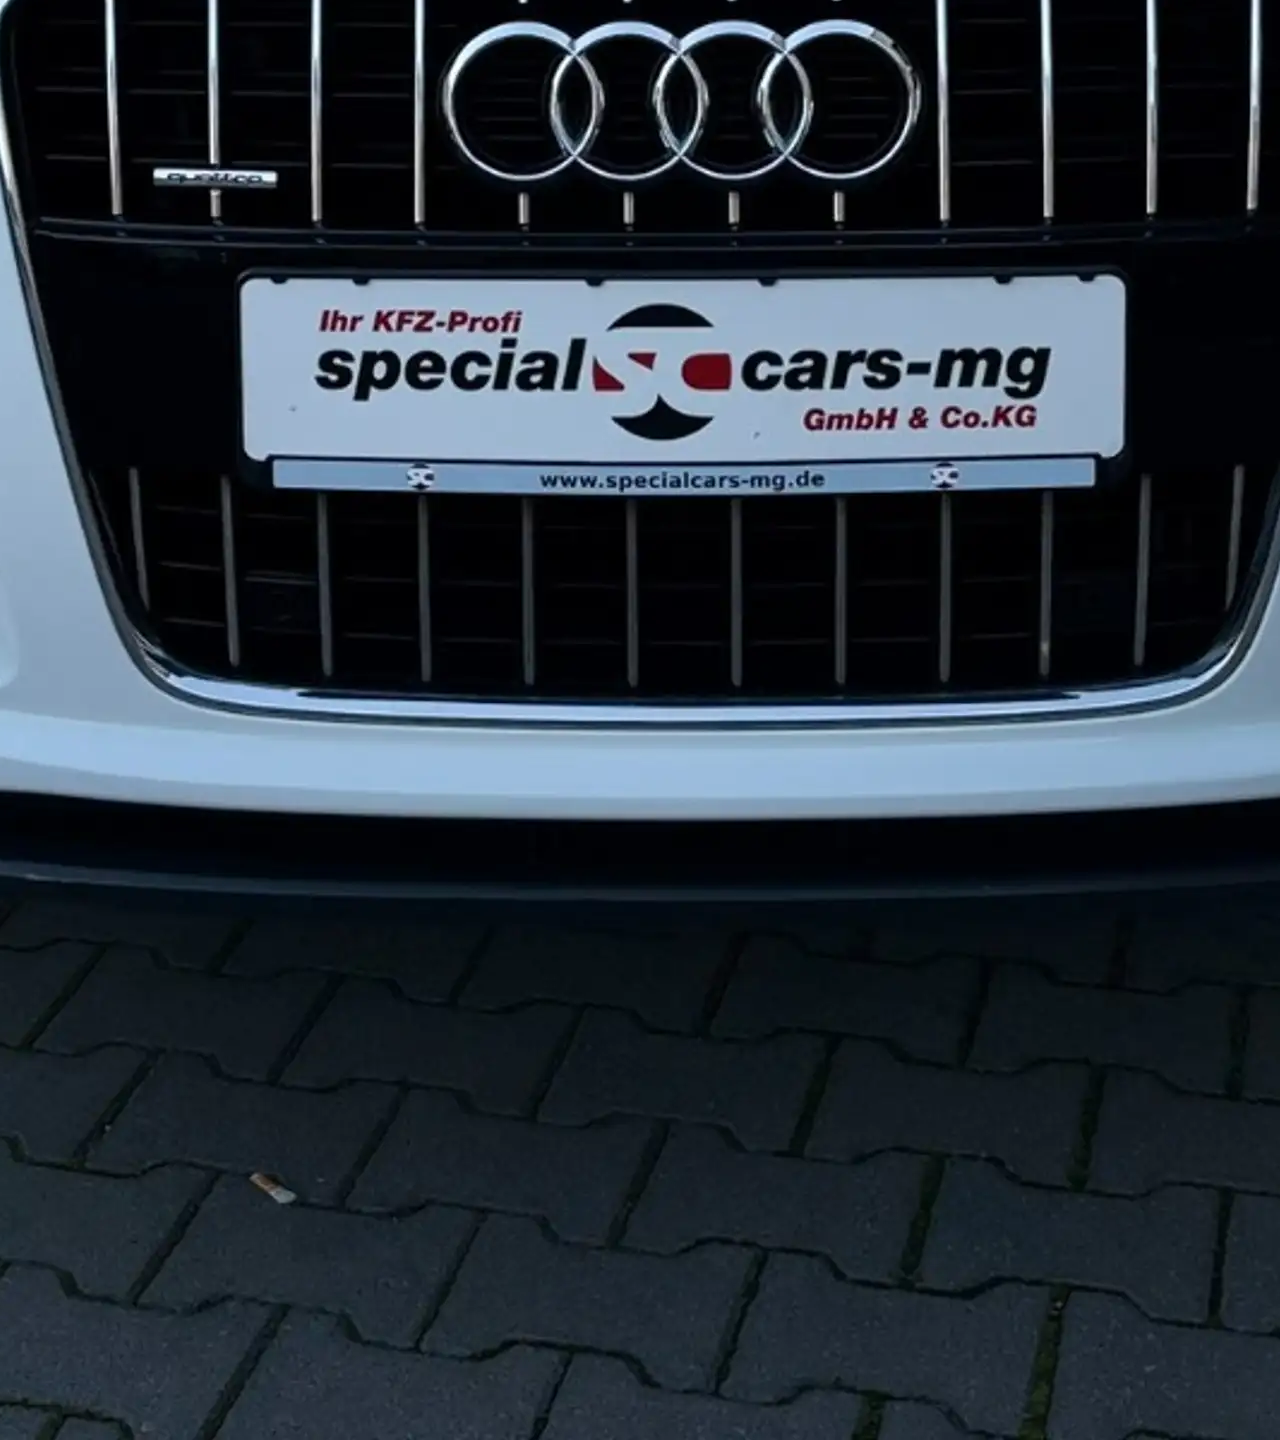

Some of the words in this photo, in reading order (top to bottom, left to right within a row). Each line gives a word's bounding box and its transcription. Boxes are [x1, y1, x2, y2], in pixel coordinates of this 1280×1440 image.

[319, 310, 364, 333] Ihr
[372, 310, 522, 333] KFZ-Profi
[314, 337, 587, 402] special
[741, 346, 1052, 399] cars-mg
[803, 407, 899, 431] GmbH
[907, 406, 929, 429] &
[939, 404, 1038, 429] Co.KG
[540, 470, 825, 492] www.specialcars-mg.de
